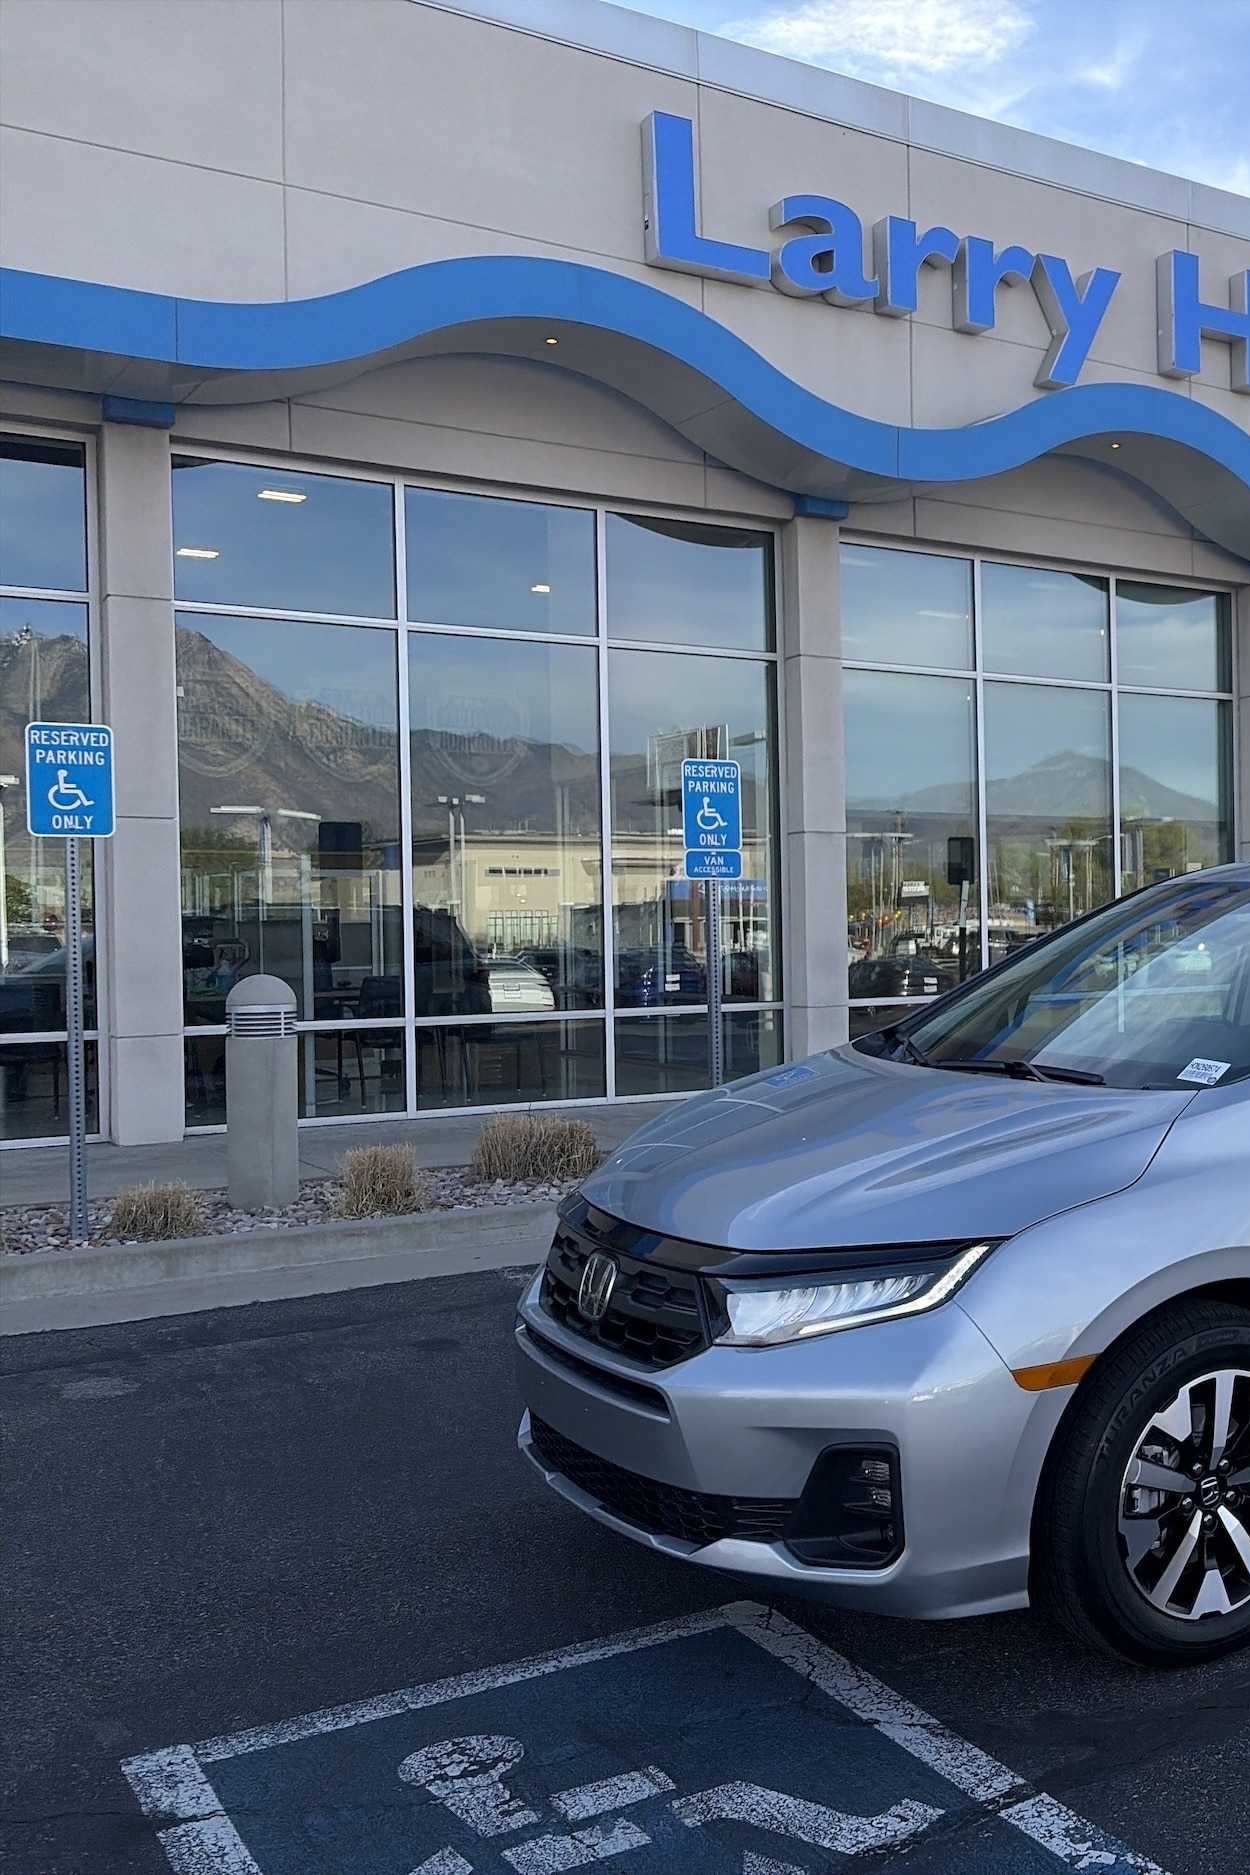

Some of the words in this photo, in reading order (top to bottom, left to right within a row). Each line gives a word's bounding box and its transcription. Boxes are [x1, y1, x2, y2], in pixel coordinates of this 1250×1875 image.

[642, 110, 1122, 390] Larry
[30, 730, 109, 747] RESERVED
[35, 750, 105, 766] PARKING
[684, 764, 737, 779] RESERVED
[688, 781, 735, 794] PARKING
[51, 814, 94, 830] ONLY
[699, 833, 728, 846] ONLY
[703, 856, 724, 866] VAN
[693, 866, 735, 874] ACCESSIBLE
[1096, 1346, 1188, 1464] TURANZA
